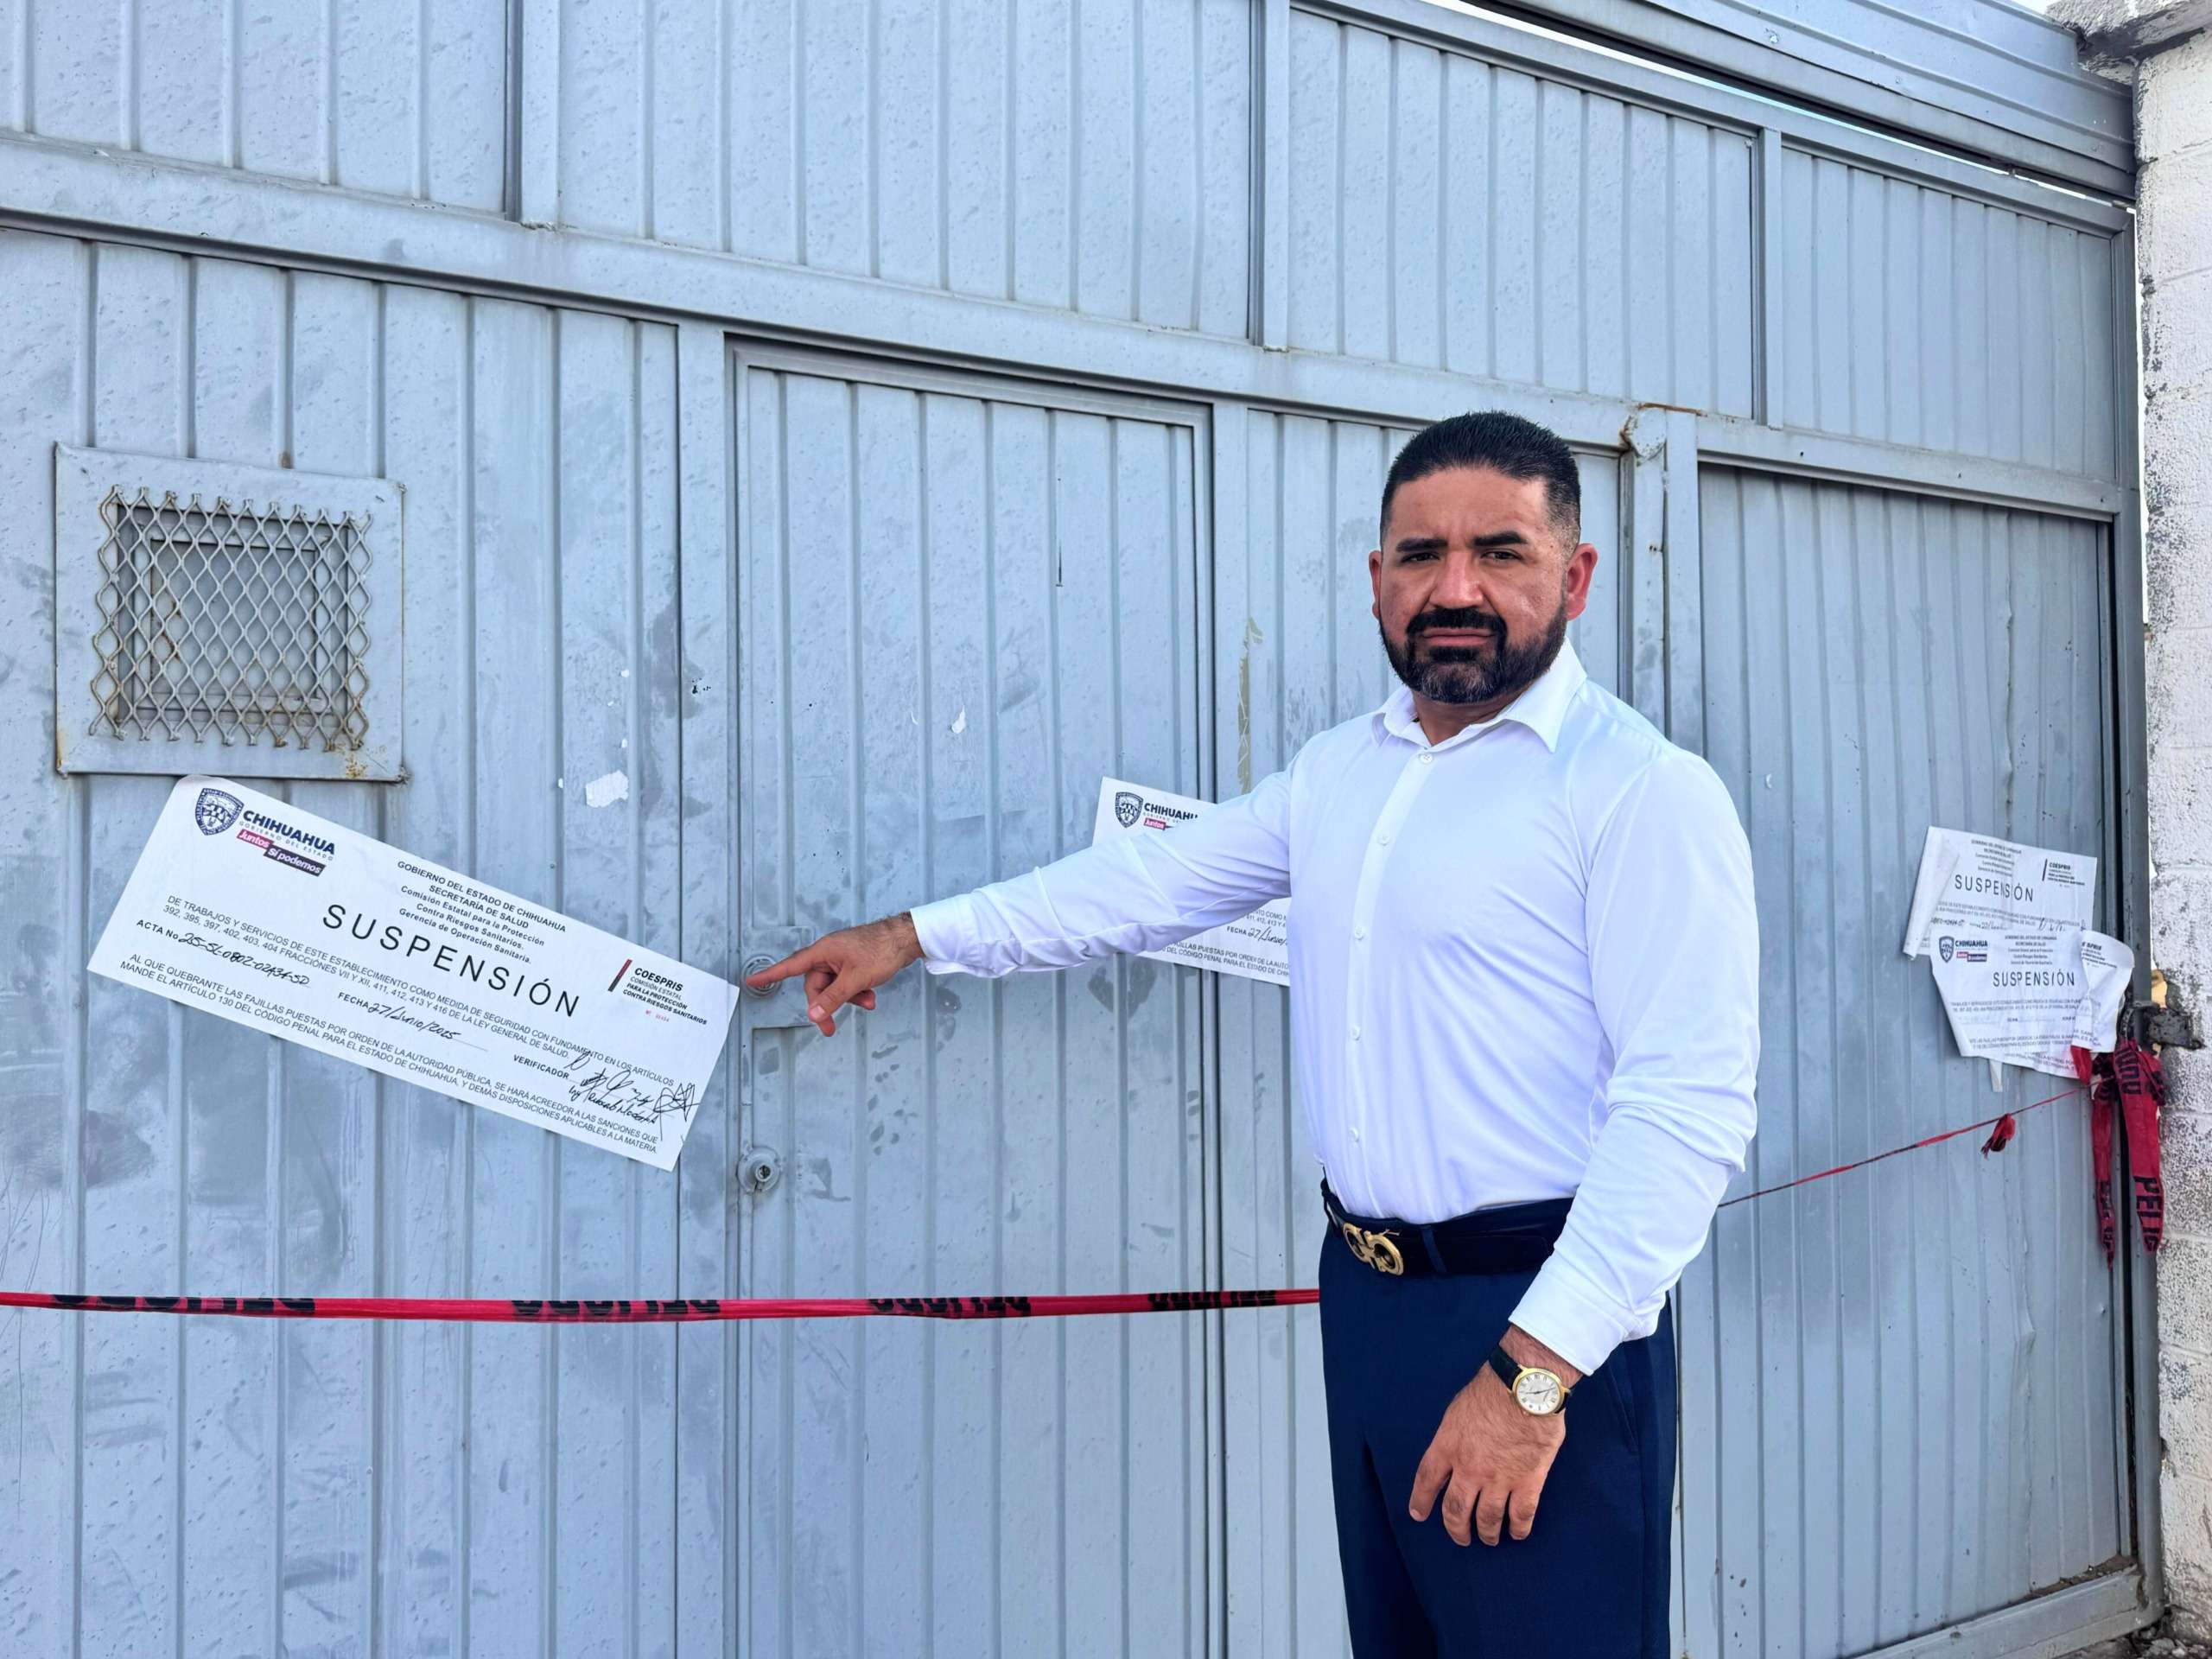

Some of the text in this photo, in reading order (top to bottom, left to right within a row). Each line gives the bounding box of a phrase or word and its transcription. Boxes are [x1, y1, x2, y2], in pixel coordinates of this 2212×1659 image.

[238, 830, 269, 848] Juntos
[238, 820, 334, 861] GOBIERNO DEL ESTADO
[243, 810, 334, 854] CHIHUAHUA
[267, 848, 321, 873] Sí podemos
[397, 861, 565, 931] GOBIERNO DEL ESTADO DE CHIHUAHUA
[136, 919, 178, 939] ACTA No
[401, 885, 543, 945] Comisión Estatal para la Protección
[416, 903, 523, 949] Contra Riesgos Sanitarios.
[485, 906, 499, 917] DE
[499, 912, 528, 928] SALUD
[1226, 925, 1246, 935] FECHA
[399, 907, 531, 963] Gerencia de Operación Sanitaria.
[162, 905, 180, 918] 392,
[182, 912, 200, 925] 395,
[203, 919, 220, 932] 397,
[223, 927, 239, 940] 402,
[242, 934, 259, 947] 403,
[262, 942, 277, 952] 404
[339, 969, 350, 978] VII
[357, 976, 370, 988] XII,
[372, 982, 388, 994] 411,
[391, 988, 406, 1001] 412,
[409, 995, 424, 1006] 413
[432, 1004, 448, 1014] 416
[448, 1008, 461, 1019] DE
[461, 1014, 472, 1023] LA
[473, 1018, 490, 1028] LEY
[490, 1024, 527, 1043] GENERAL
[529, 1038, 541, 1048] DE
[322, 904, 580, 1017] SUSPENSIÓN
[1993, 969, 2075, 987] SUSPENSIÓN
[167, 895, 181, 906] DE
[184, 900, 231, 925] TRABAJOS
[240, 922, 289, 945] SERVICIOS
[289, 940, 303, 951] DE
[304, 946, 328, 960] ESTE
[329, 955, 408, 988] ESTABLECIMIENTO
[409, 984, 435, 999] COMO
[436, 995, 468, 1012] MEDIDA
[469, 1006, 482, 1016] DE
[483, 1011, 531, 1033] SEGURIDAD
[531, 1029, 550, 1040] CON
[550, 1036, 603, 1060] FUNDAMENTO
[604, 1055, 616, 1065] EN
[615, 1059, 632, 1071] LOS
[626, 982, 641, 992] PARA
[649, 991, 687, 1009] PROTECCIÓN
[630, 976, 681, 1000] COMISIÓN ESTATAL
[634, 968, 683, 991] COESPRIS
[338, 992, 368, 1007] FECHA
[622, 988, 646, 1001] CONTRA
[645, 997, 672, 1011] RIESGOS
[672, 1008, 707, 1025] SANITARIOS
[120, 961, 156, 979] MANDE
[156, 973, 167, 984] EL
[219, 995, 233, 1006] 130
[234, 1001, 251, 1014] DEL
[254, 1008, 290, 1026] CÓDIGO
[291, 1021, 319, 1037] PENAL
[321, 1032, 345, 1046] PARA
[346, 1040, 356, 1050] EL
[358, 1045, 393, 1062] ESTADO
[394, 1057, 408, 1067] DE
[499, 1093, 560, 1120] DISPOSICIONES
[560, 1115, 607, 1135] APLICABLES
[613, 1133, 623, 1141] LA
[129, 953, 141, 963] AL
[143, 958, 165, 971] QUE
[166, 966, 223, 992] QUEBRANTE
[224, 987, 243, 999] LAS
[244, 994, 284, 1014] FAJILLAS
[285, 1008, 326, 1028] PUESTAS
[327, 1023, 346, 1035] POR
[348, 1031, 379, 1046] ORDEN
[380, 1041, 394, 1052] DE
[394, 1046, 404, 1056] LA
[405, 1052, 454, 1073] AUTORIDAD
[493, 1081, 506, 1091] SE
[530, 1095, 574, 1115] ACREEDOR
[581, 1112, 596, 1122] LAS
[597, 1117, 640, 1137] SANCIONES
[641, 1133, 658, 1144] QUE
[513, 1054, 569, 1079] VERIFICADOR
